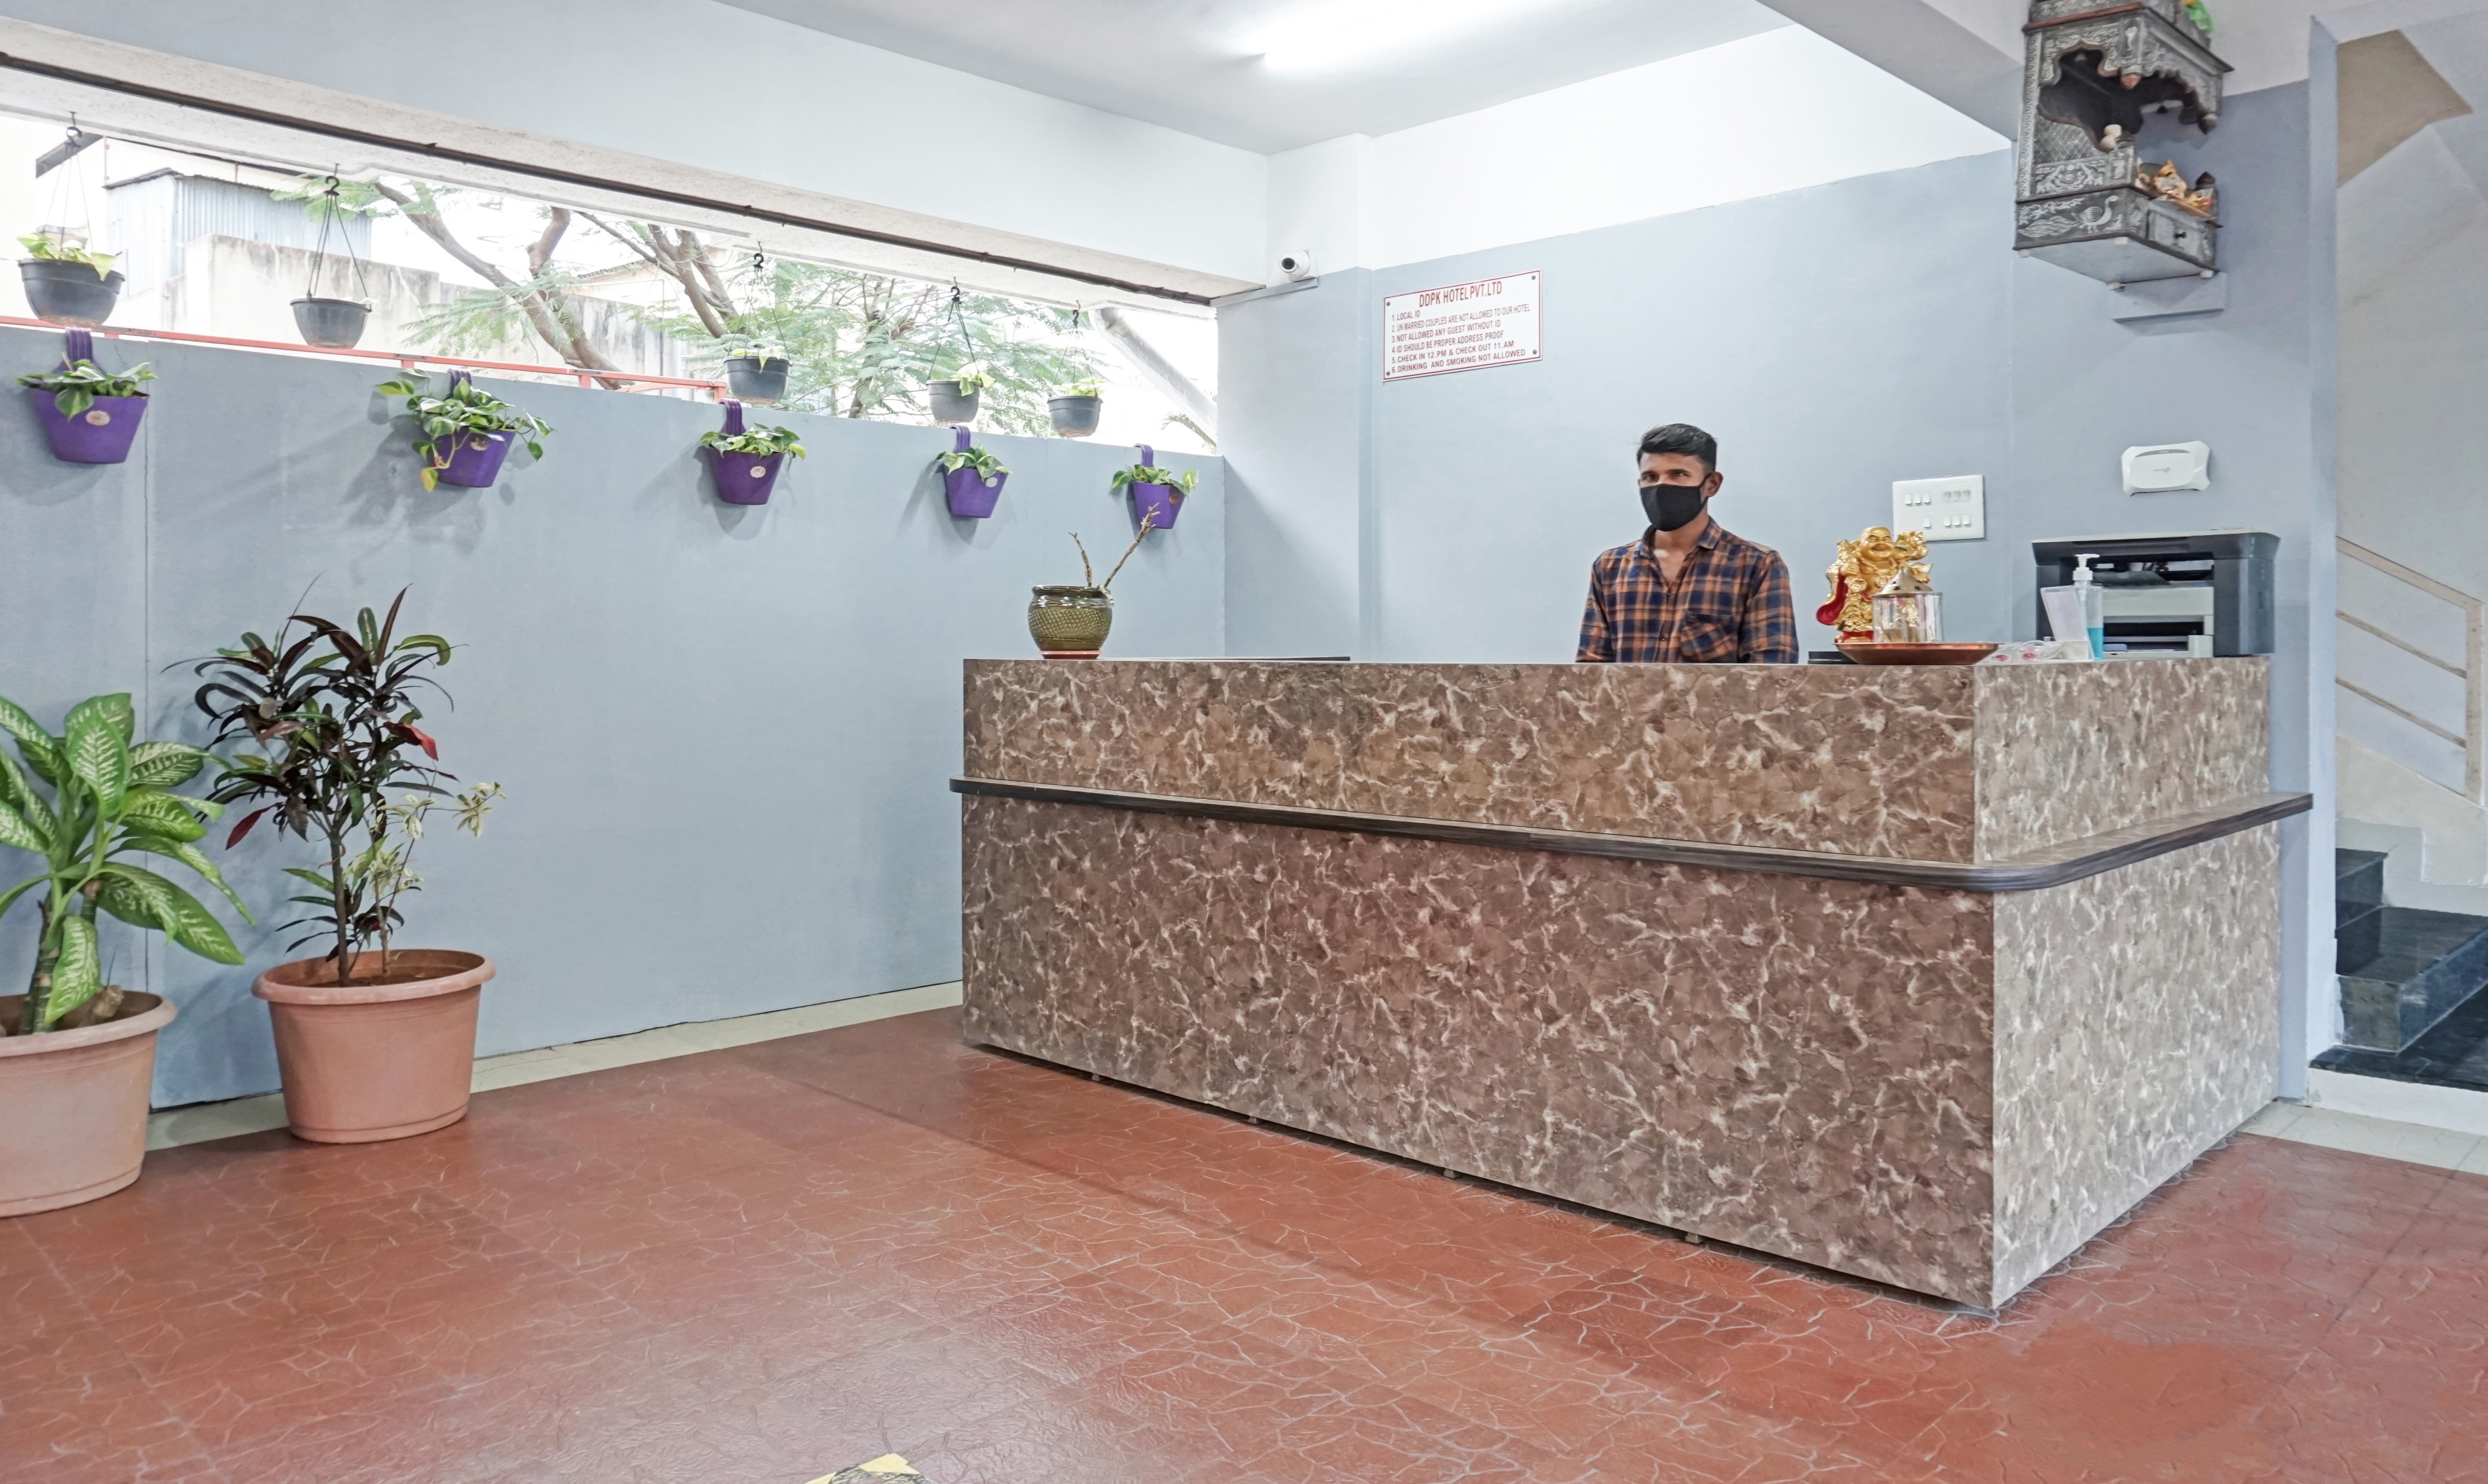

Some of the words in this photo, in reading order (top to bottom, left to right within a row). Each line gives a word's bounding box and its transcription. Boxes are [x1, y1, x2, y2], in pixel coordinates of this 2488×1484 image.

[1419, 291, 1441, 307] DDPK
[1443, 287, 1468, 303] HOTEL
[1404, 320, 1424, 330] MARRIED
[1425, 316, 1447, 327] COUPLES
[1448, 315, 1458, 323] ARE
[1459, 313, 1469, 322] NOT
[1469, 310, 1493, 320] ALLOWED
[1494, 308, 1501, 316] TO
[1502, 306, 1513, 315] OUR
[1514, 304, 1531, 313] HOTEL
[1408, 330, 1434, 340] ALLOWED
[1435, 327, 1446, 336] ANY
[1447, 325, 1465, 334] GUEST
[1467, 321, 1493, 332] WITHOUT
[1495, 319, 1501, 327] ID
[1403, 342, 1425, 352] SHOULD
[1426, 340, 1432, 349] BE
[1434, 337, 1456, 348] PROPER
[1457, 333, 1483, 344] ADDRESS
[1485, 330, 1504, 340] PROOF
[1456, 346, 1476, 355] CHECK
[1478, 343, 1491, 352] OUT
[1431, 360, 1444, 368] AND
[1446, 355, 1476, 366] SMOKING
[1478, 353, 1491, 362] NOT
[1493, 349, 1526, 359] ALLOWED
